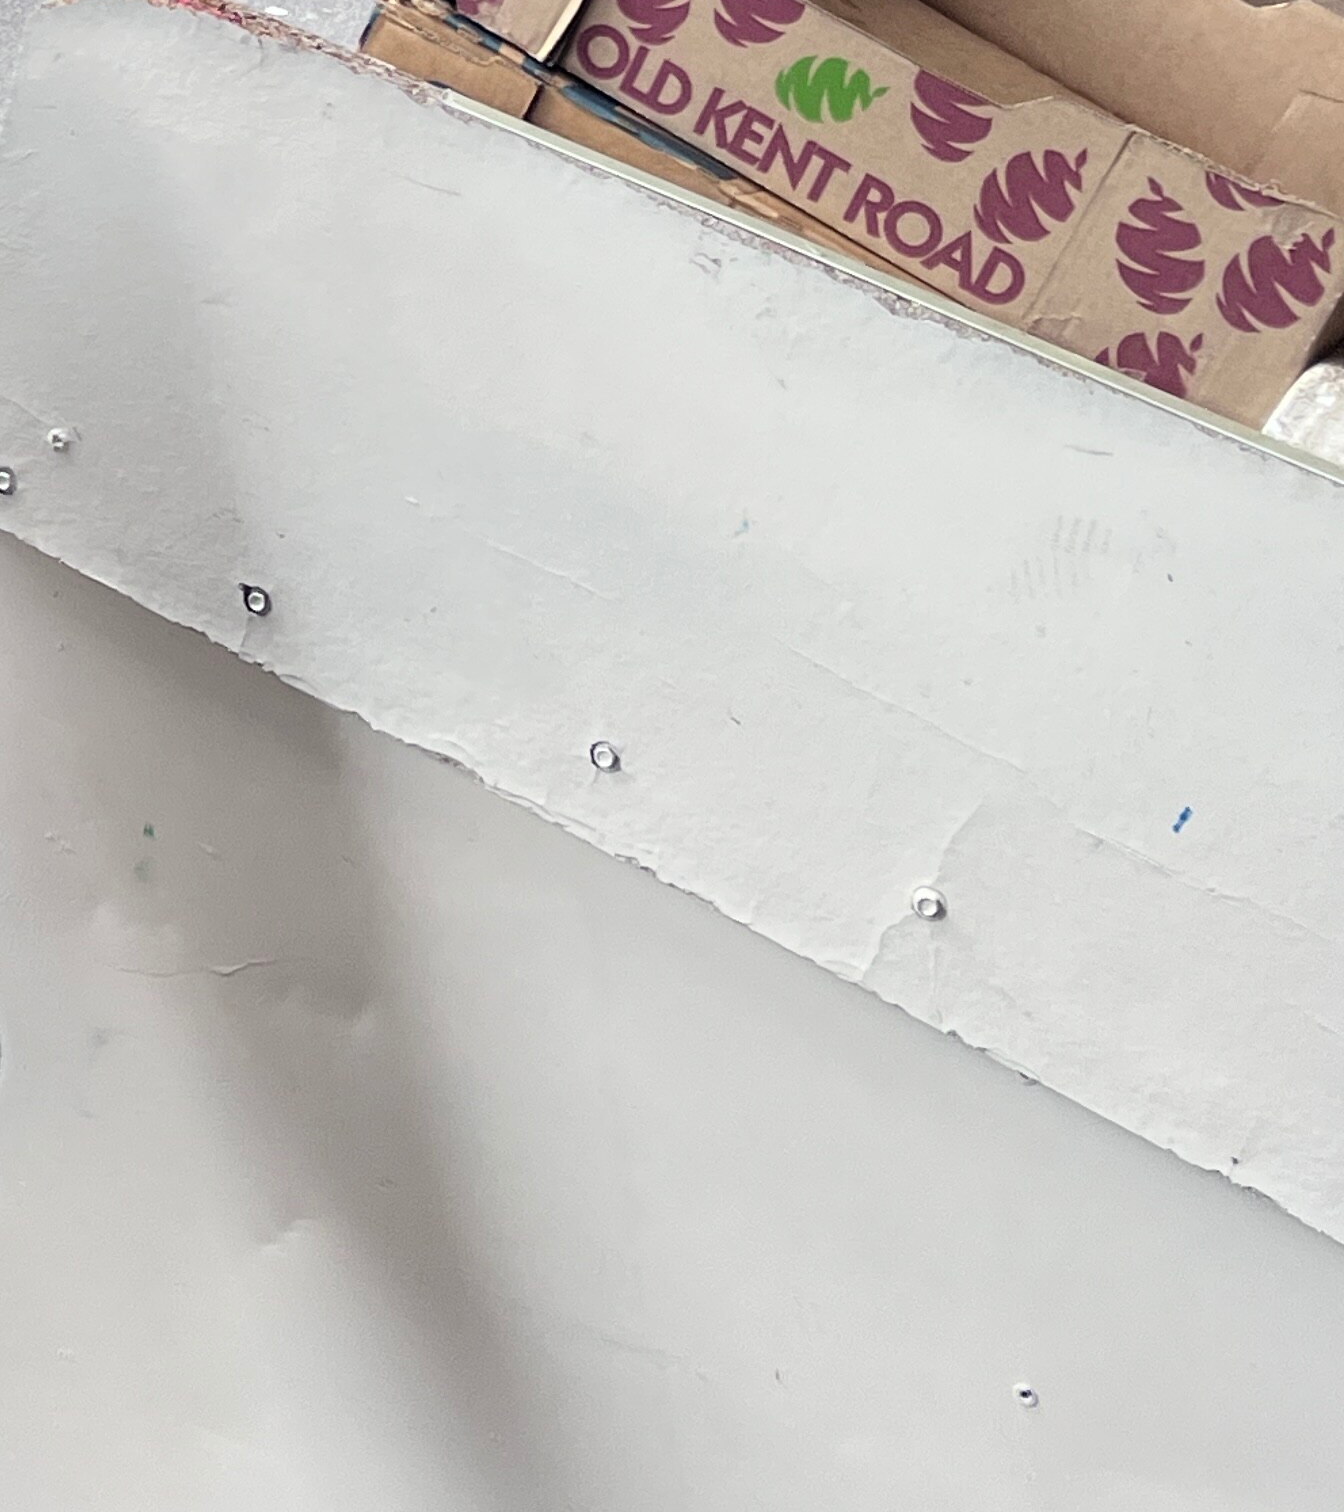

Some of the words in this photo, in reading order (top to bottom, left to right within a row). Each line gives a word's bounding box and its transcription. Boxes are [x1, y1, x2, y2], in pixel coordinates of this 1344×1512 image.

[576, 23, 693, 116] OLD
[692, 86, 853, 204] KENT
[842, 172, 1027, 306] ROAD
